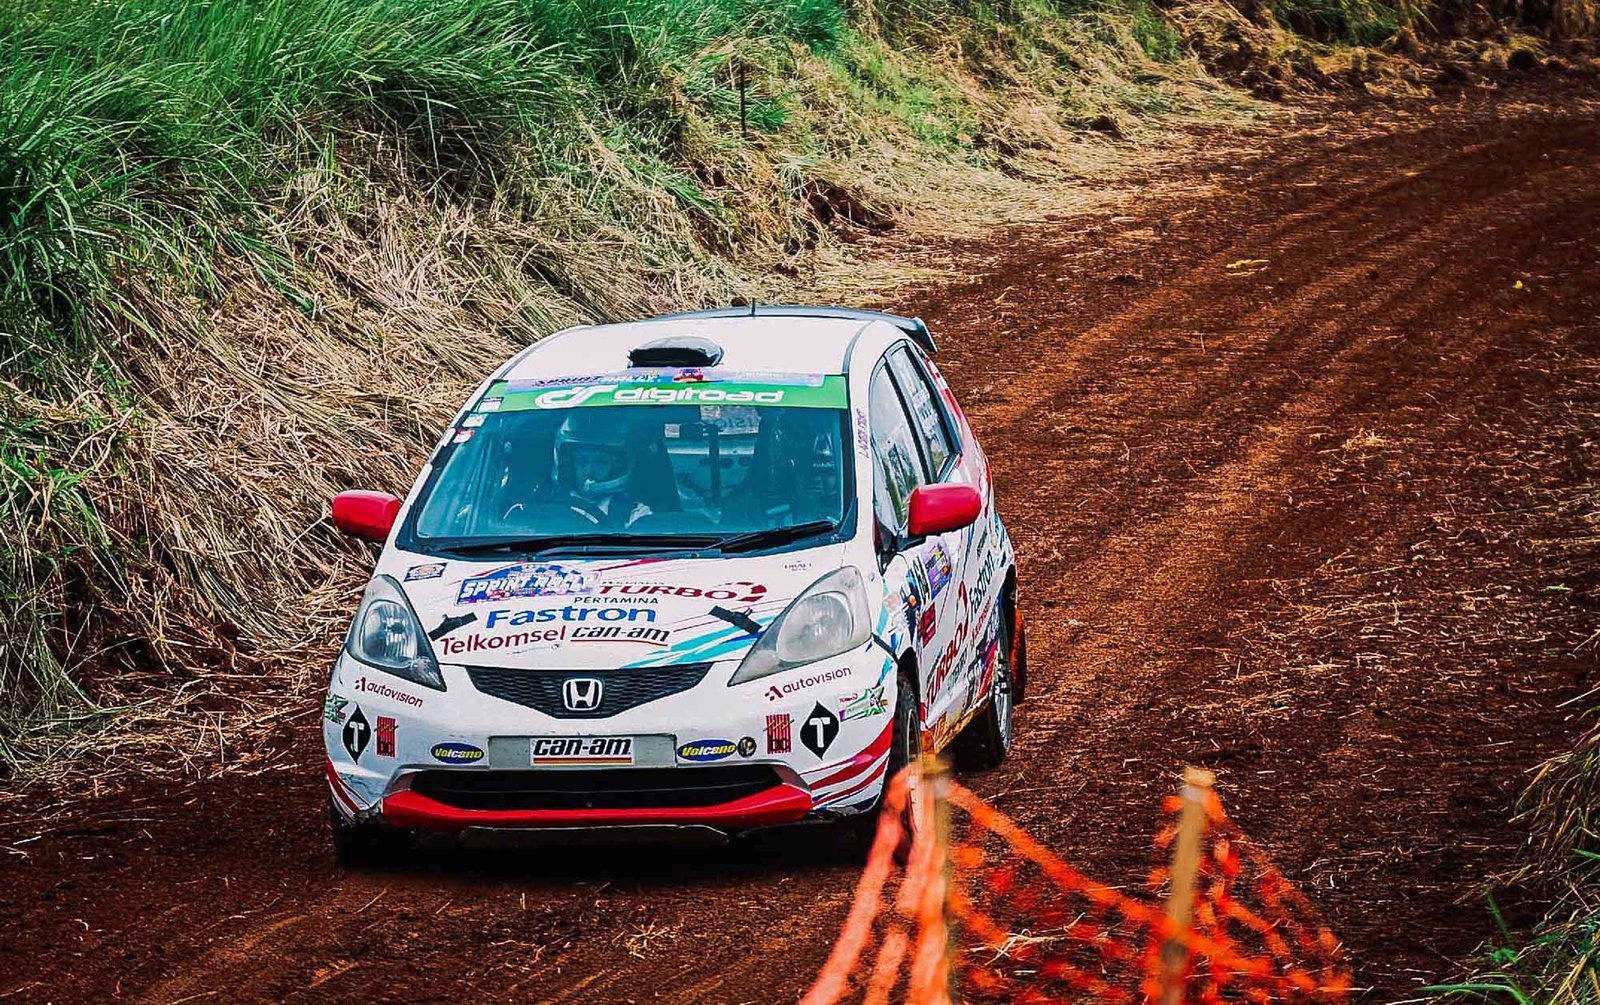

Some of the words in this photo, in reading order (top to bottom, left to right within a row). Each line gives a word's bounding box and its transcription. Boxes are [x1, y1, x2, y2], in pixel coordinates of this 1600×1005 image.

[613, 387, 785, 404] digiroad
[574, 595, 659, 605] PERTAMINA
[600, 584, 738, 601] TURBO
[485, 605, 657, 629] Fastron
[440, 624, 567, 656] Telkomsel
[570, 625, 671, 643] can-am
[781, 666, 852, 695] autovision
[366, 681, 424, 708] autovision
[434, 747, 483, 760] Volcano
[532, 736, 632, 757] can-am
[681, 744, 736, 757] Volcano
